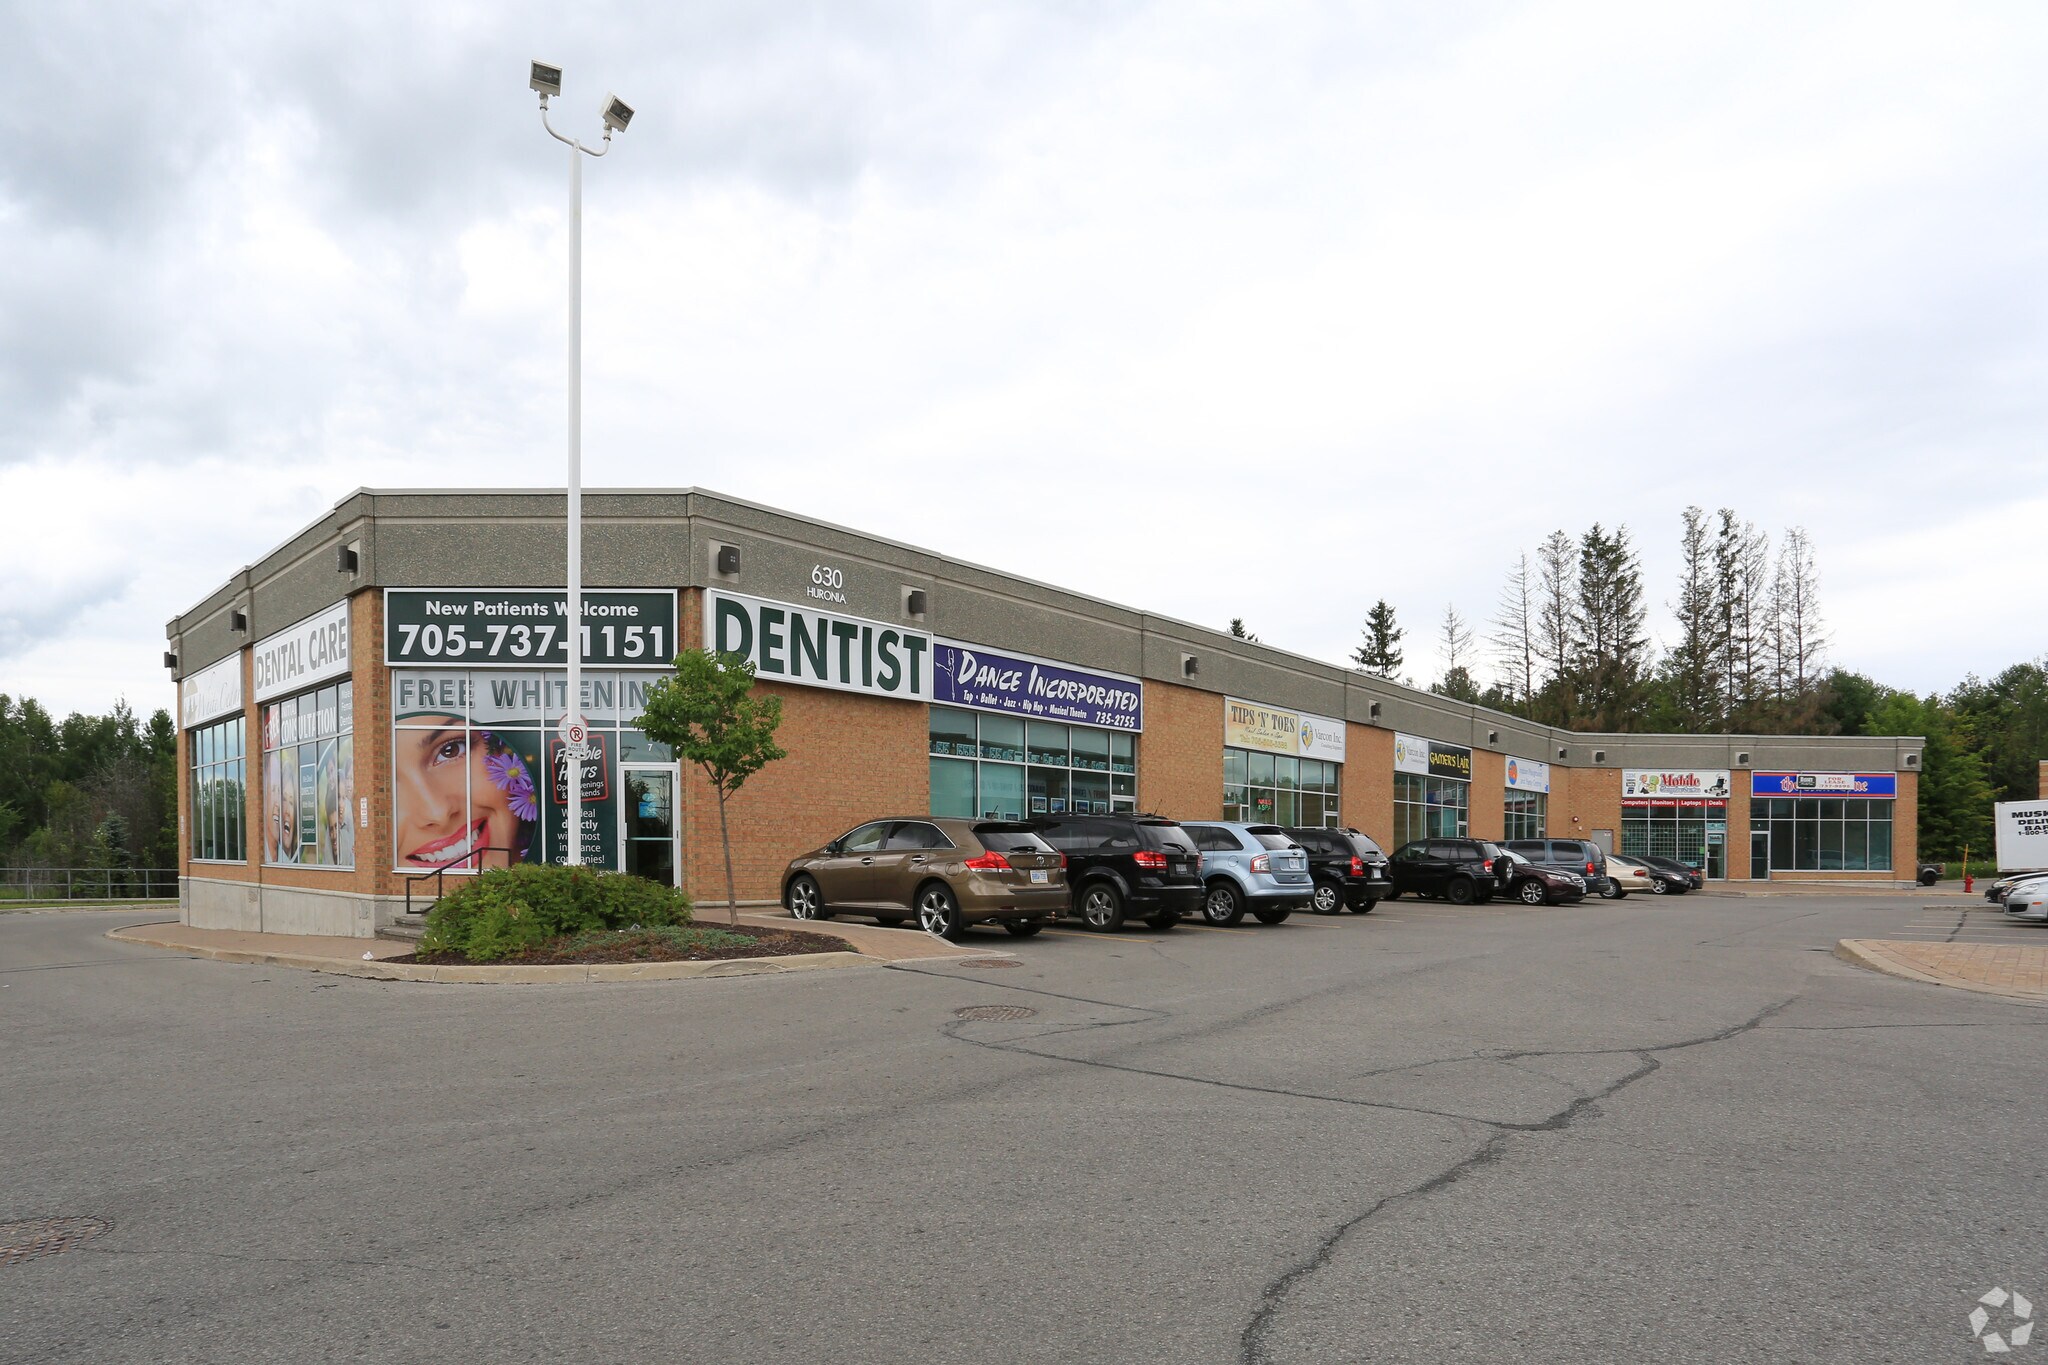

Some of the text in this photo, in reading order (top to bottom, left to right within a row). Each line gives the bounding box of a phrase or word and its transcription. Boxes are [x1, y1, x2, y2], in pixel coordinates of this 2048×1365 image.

[811, 564, 843, 589] 630
[806, 586, 847, 605] HURONIA
[425, 600, 468, 616] New
[473, 601, 549, 616] Patients
[398, 623, 664, 657] 705-737-1151
[715, 597, 928, 695] DENTIST
[256, 617, 347, 690] DENTAL CARE
[957, 650, 1139, 712] DANCE INCORPORATED
[399, 679, 668, 709] FREE WHITENIN
[963, 690, 1087, 719] Tap Ballet Jazz Hip Hop Musical Theatre
[1095, 711, 1136, 728] 735-2755
[1231, 705, 1255, 726] TIPS
[1271, 714, 1295, 733] TOES
[555, 745, 602, 764] Flble
[648, 744, 653, 752] 7
[558, 764, 598, 781] Hrs
[1660, 773, 1701, 787] Mobile
[560, 843, 601, 852] inance
